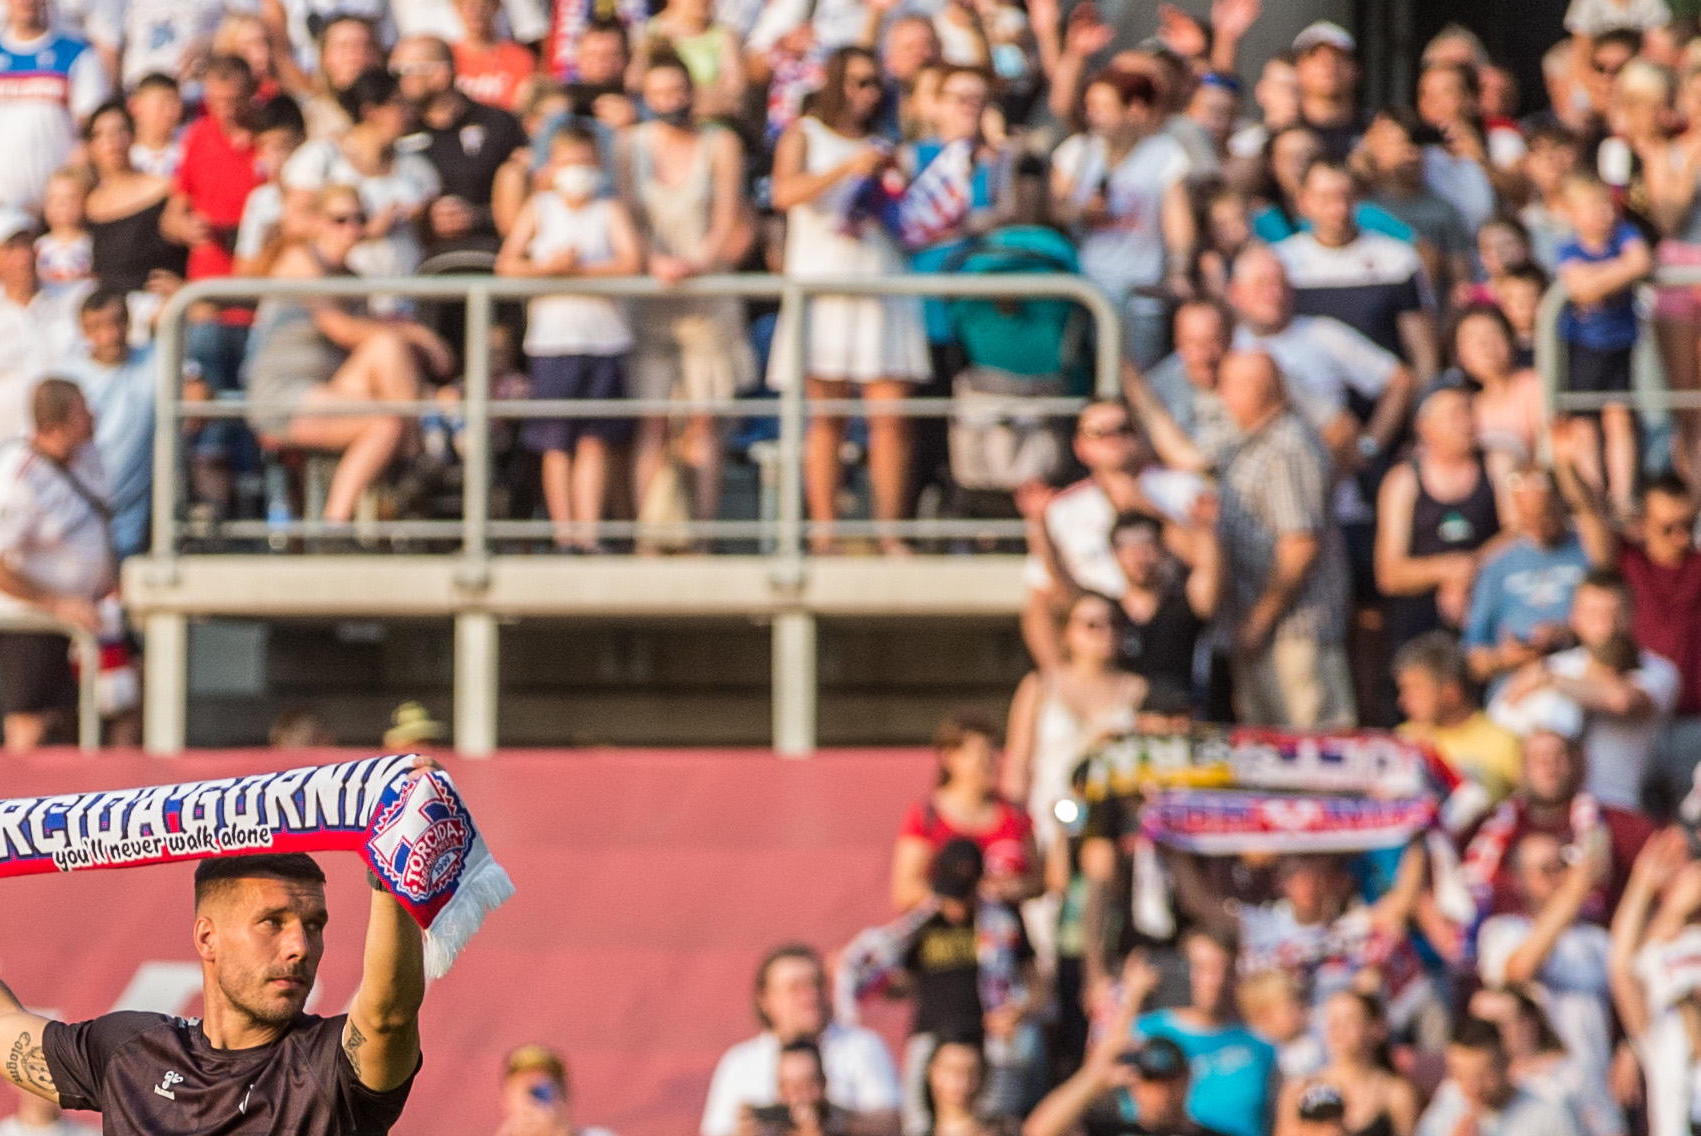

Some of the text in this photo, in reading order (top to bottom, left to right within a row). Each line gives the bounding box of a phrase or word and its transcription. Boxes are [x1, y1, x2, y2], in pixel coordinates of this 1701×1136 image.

[56, 822, 270, 872] you'll never walk alone
[406, 822, 458, 882] TORCIDA
